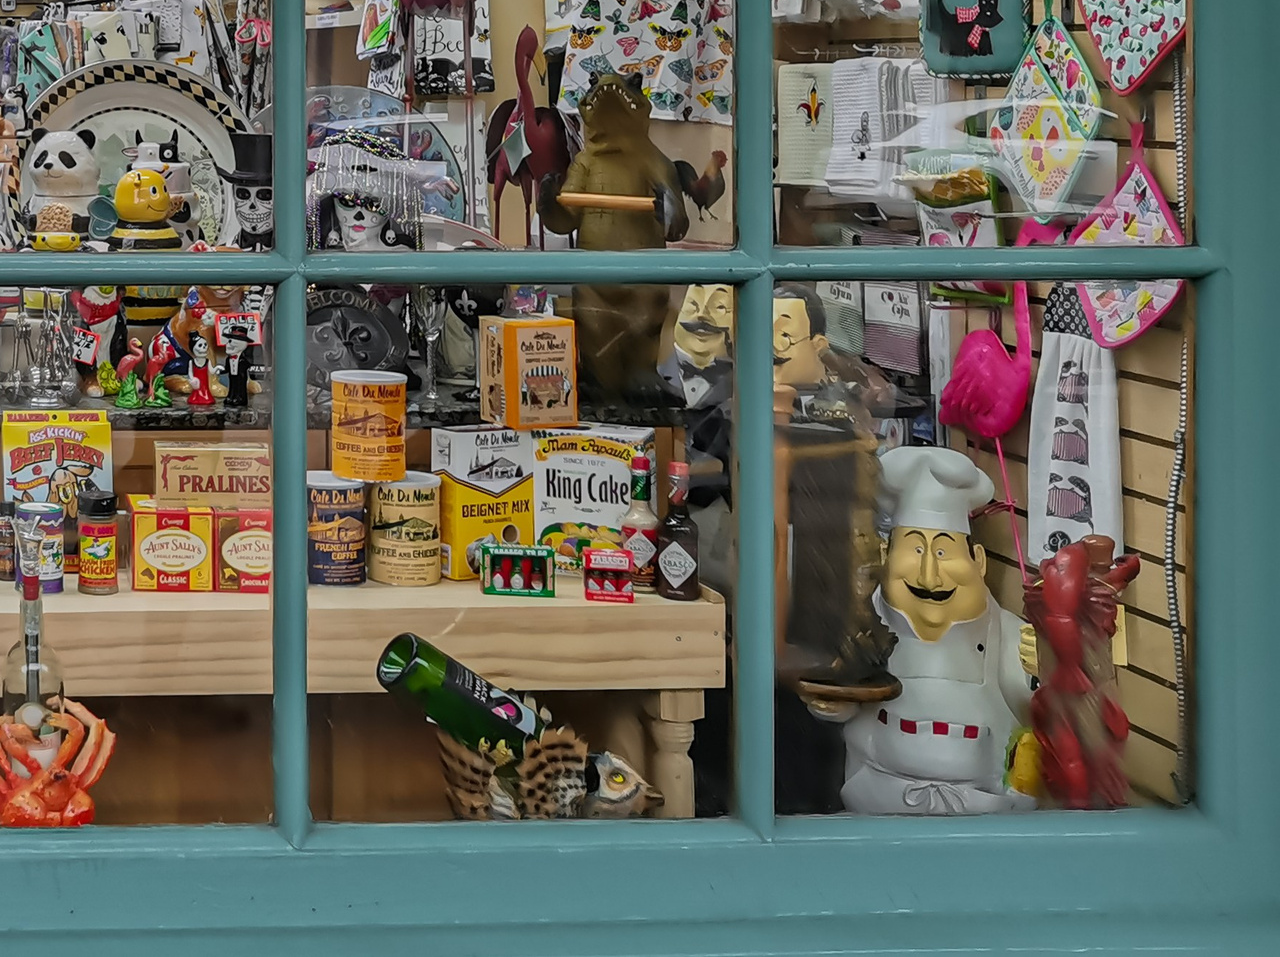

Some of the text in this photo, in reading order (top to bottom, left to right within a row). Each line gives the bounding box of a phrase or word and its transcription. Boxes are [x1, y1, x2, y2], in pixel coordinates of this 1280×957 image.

[307, 291, 378, 313] ELCOME
[220, 316, 256, 325] SALE
[362, 385, 376, 397] Du
[377, 384, 401, 398] Monde
[68, 413, 100, 422] PEPPER
[29, 430, 46, 443] ASS
[491, 433, 499, 445] Du
[336, 442, 361, 454] COFFEE
[542, 439, 632, 461] Mam Papaul's
[10, 438, 104, 474] BEEF JERKY
[563, 457, 583, 465] SINCE
[178, 475, 270, 494] PRALINES
[546, 468, 629, 505] King Cake
[333, 491, 345, 503] Du
[398, 490, 409, 501] Du
[462, 499, 530, 518] BEIGNET MIX
[144, 539, 202, 555] AUNT SALLY'S
[227, 540, 270, 555] AUNT SAL
[315, 543, 347, 552] FRENCH
[331, 551, 357, 560] COFFEE
[591, 555, 628, 567] TABASCO
[80, 564, 115, 575] CHICKEN
[661, 559, 694, 569] TABASCO
[159, 574, 187, 584] CLASSIC
[241, 578, 269, 587] CHOCOLAT
